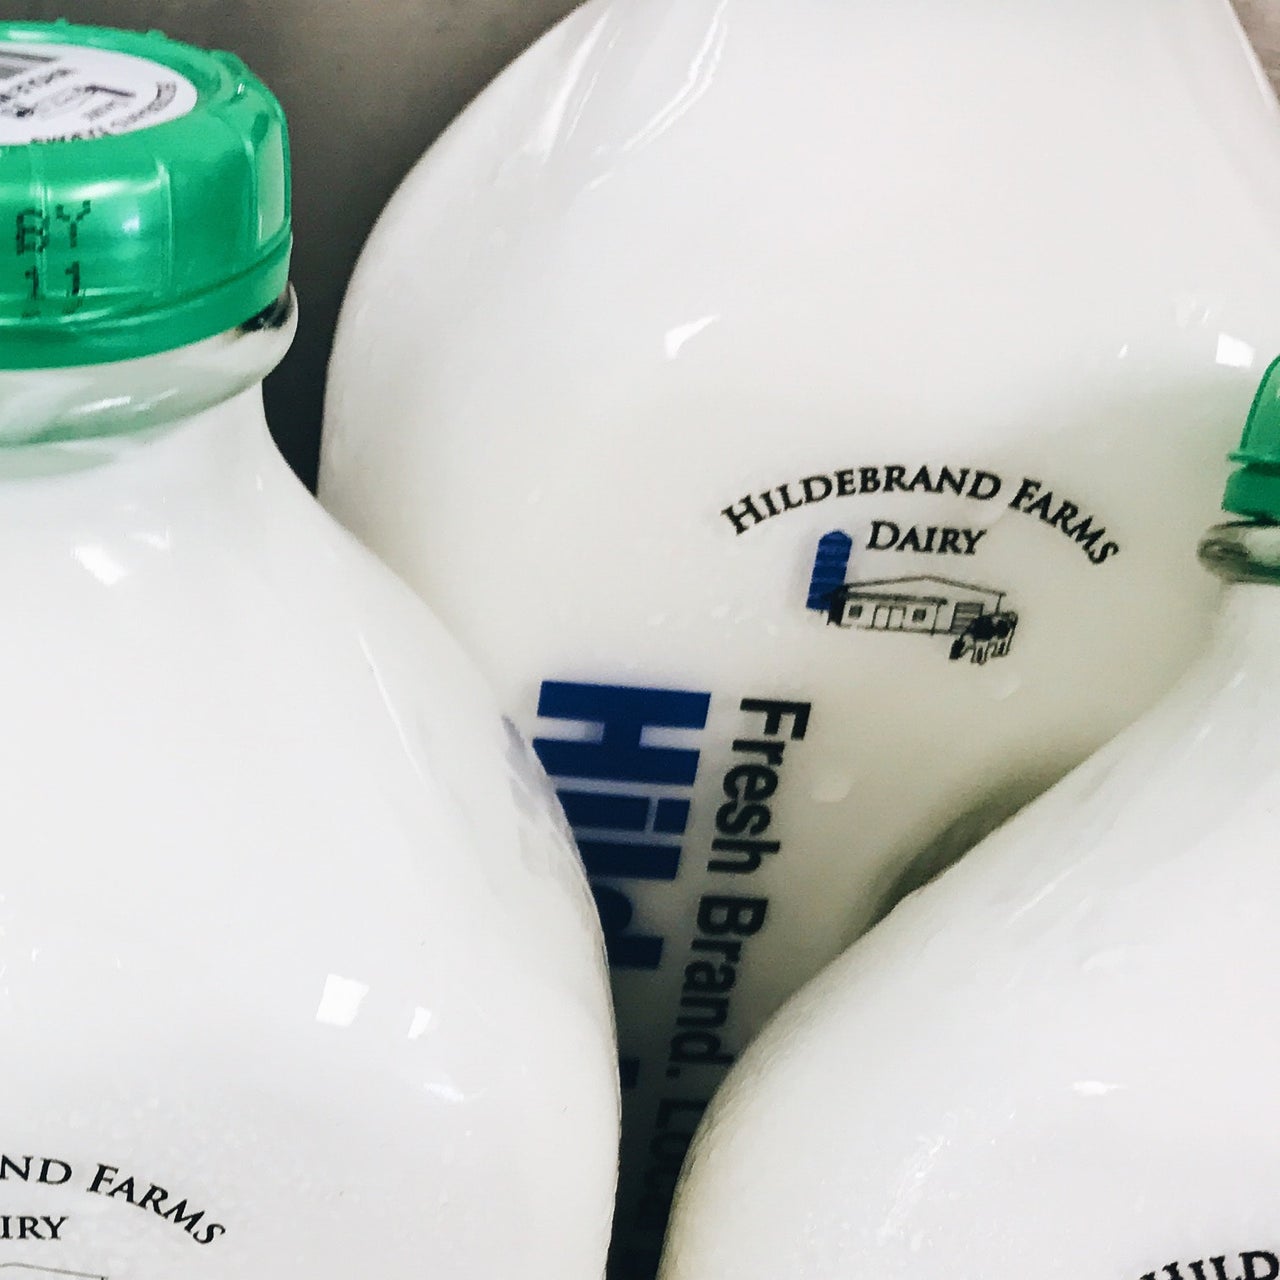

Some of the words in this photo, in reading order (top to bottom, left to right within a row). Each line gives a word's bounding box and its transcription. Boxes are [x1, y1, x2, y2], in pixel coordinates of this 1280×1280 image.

[16, 200, 91, 255] BY
[23, 261, 83, 317] 11
[721, 464, 1002, 535] HILDEBRAND
[1008, 477, 1121, 566] FARMS
[865, 520, 988, 556] DAIRY
[707, 697, 812, 876] Fresh
[665, 895, 768, 1079] Brand.
[87, 1163, 227, 1246] FARMS
